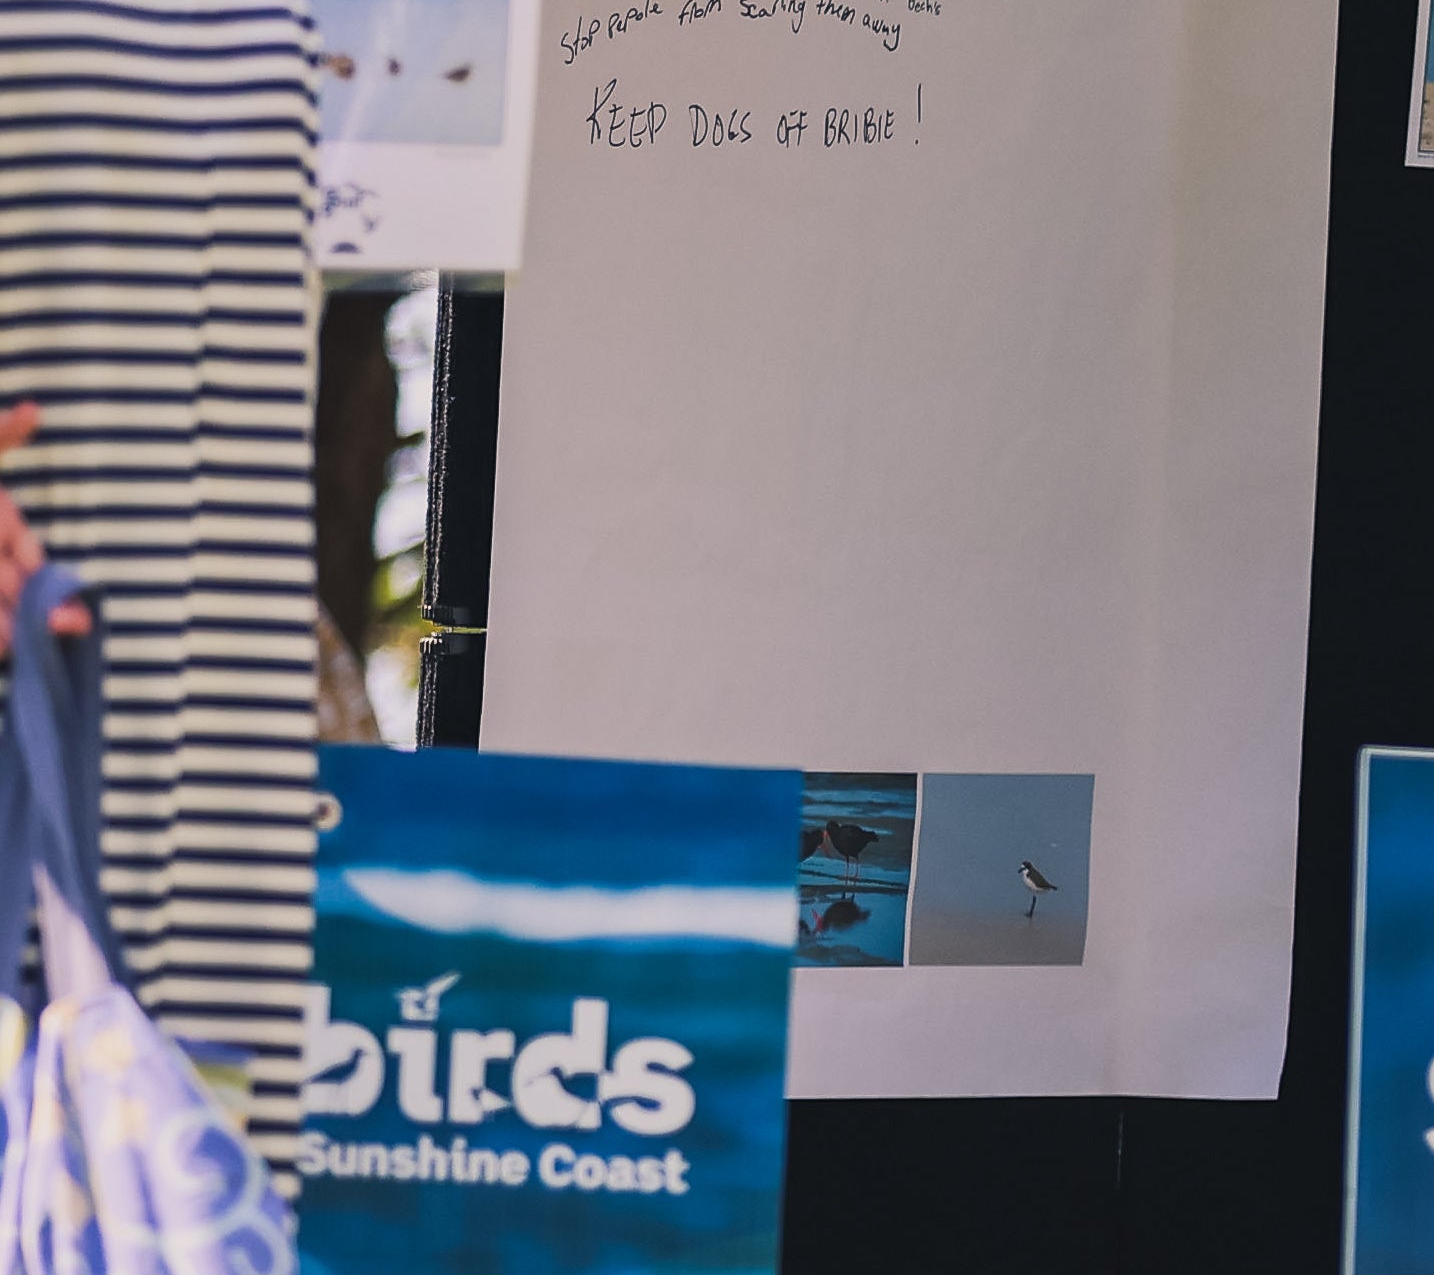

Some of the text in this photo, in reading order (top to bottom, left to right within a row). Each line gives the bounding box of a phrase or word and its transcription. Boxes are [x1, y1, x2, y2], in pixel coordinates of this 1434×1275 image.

[585, 77, 668, 149] KEEP
[688, 104, 752, 147] DOGS
[776, 110, 809, 149] OFF
[302, 971, 697, 1136] birds
[298, 1129, 690, 1195] Sunshine Coast
